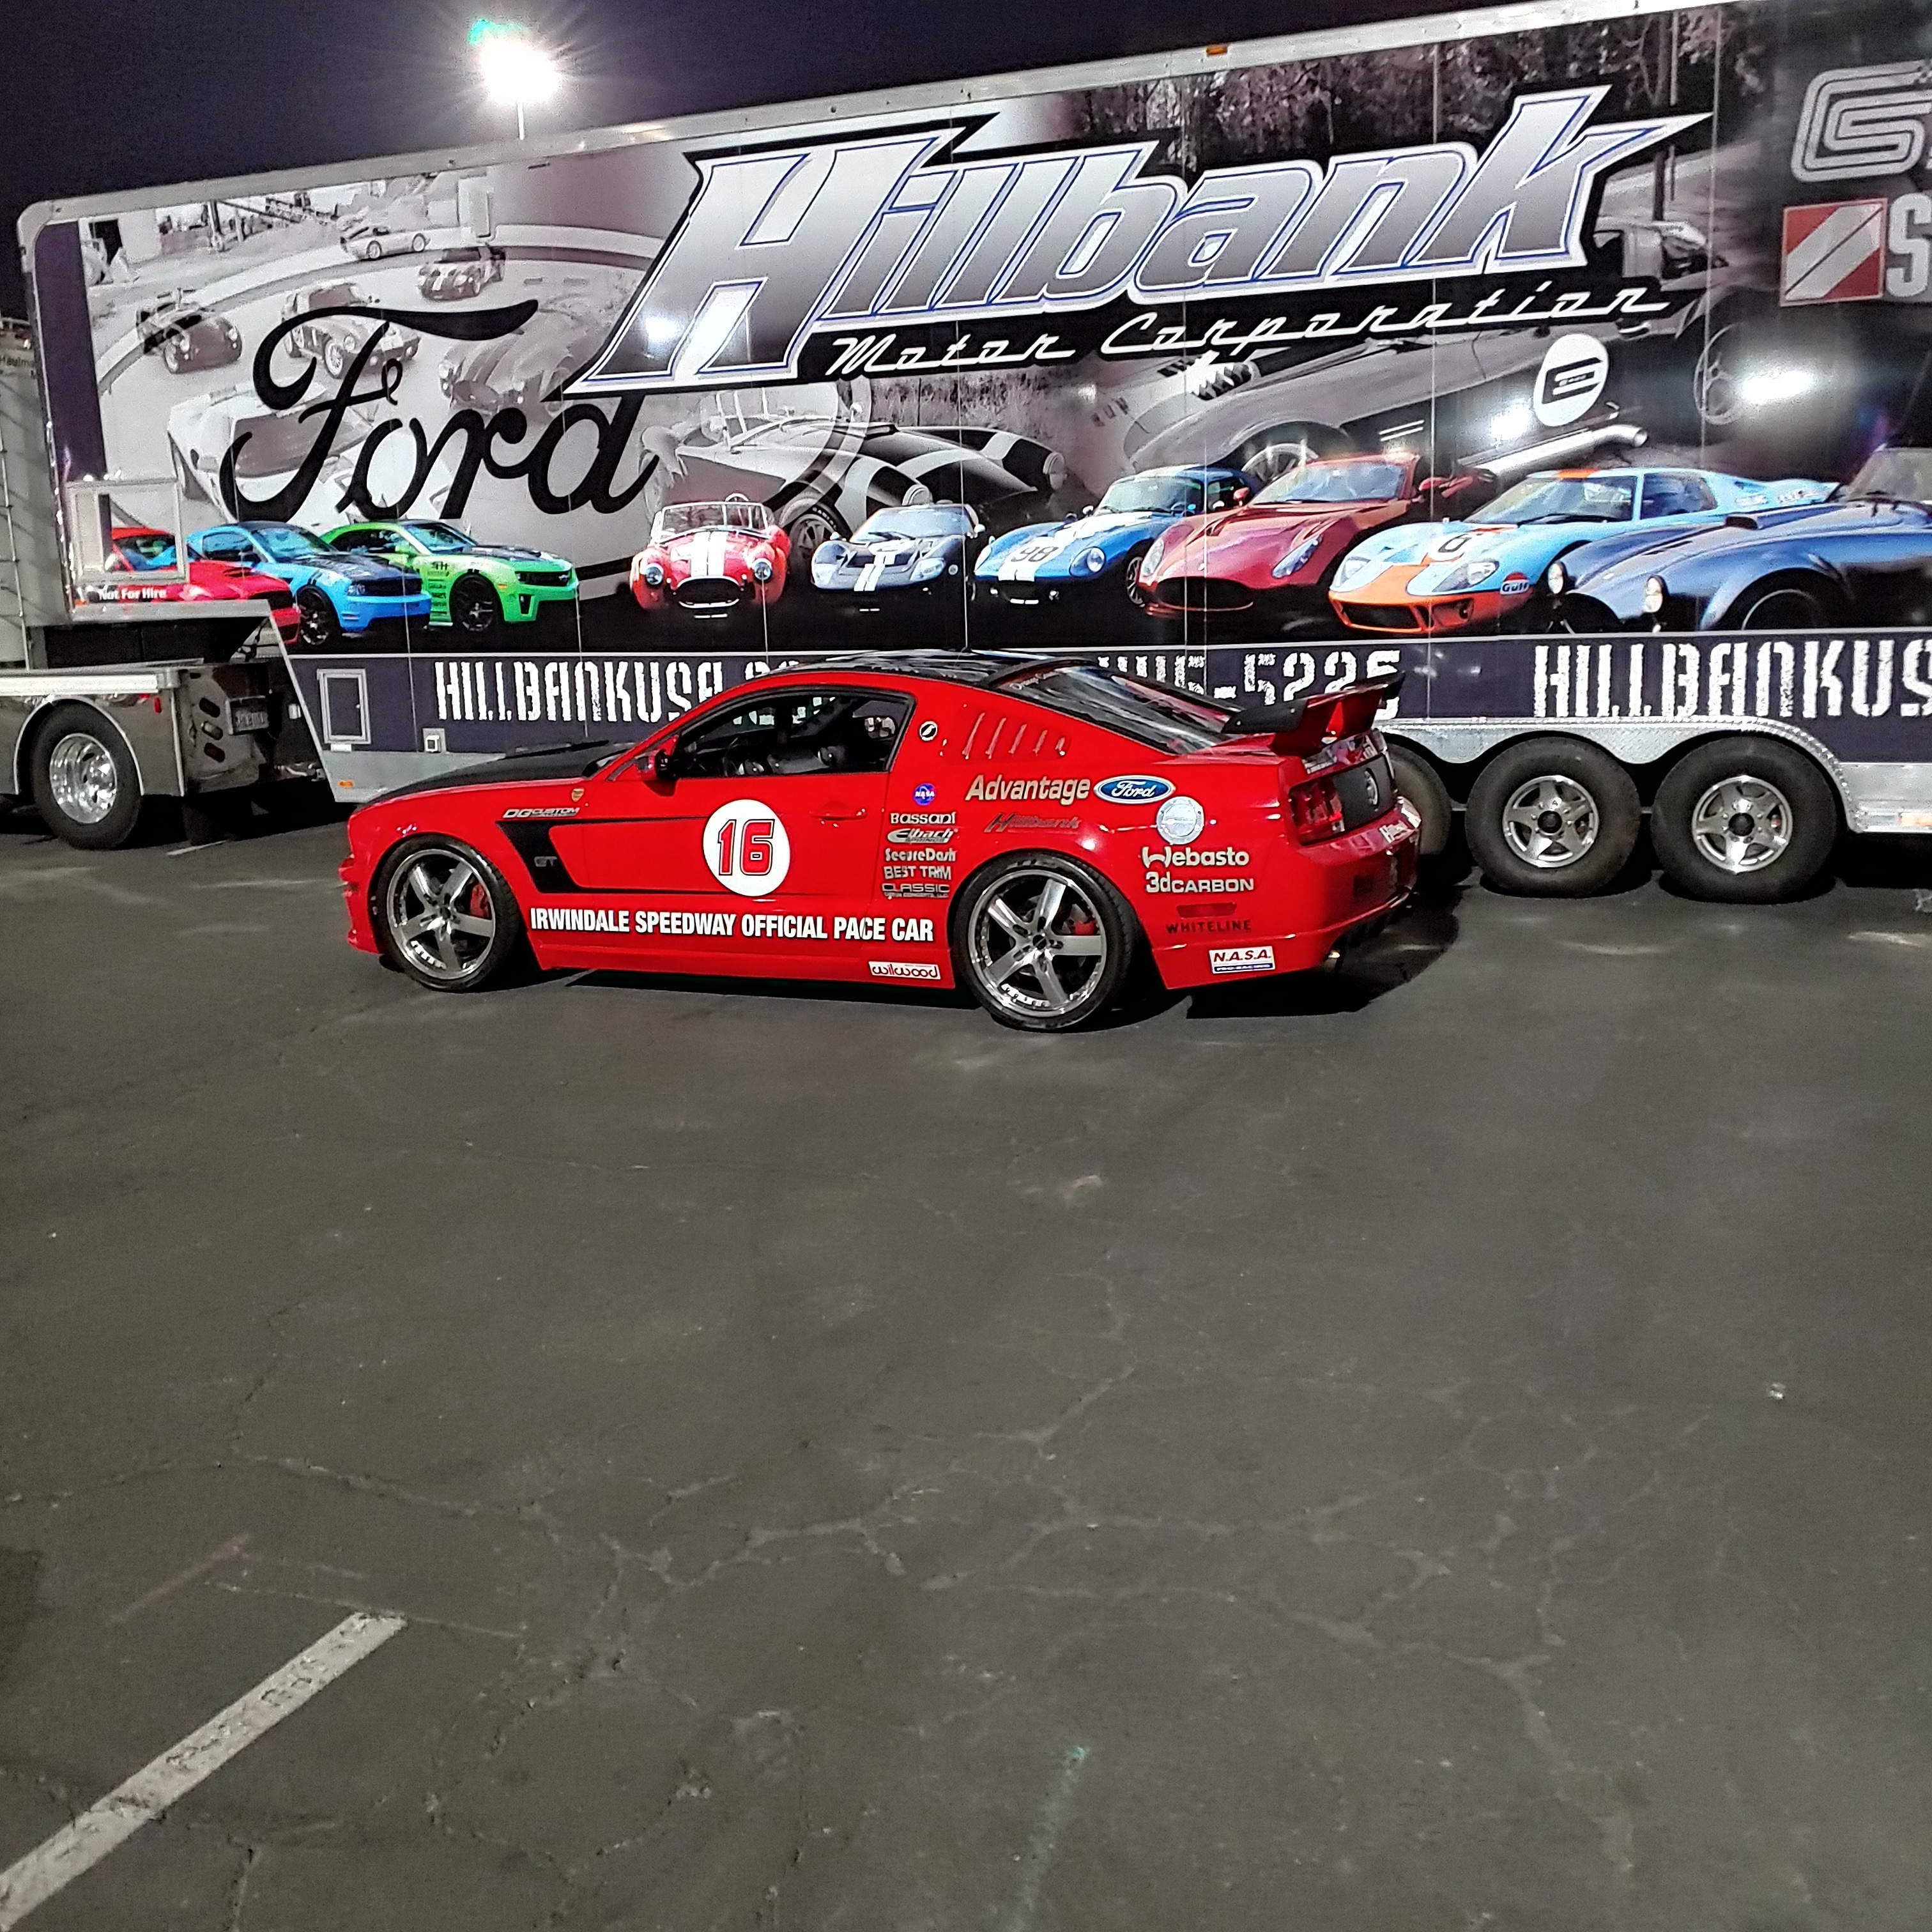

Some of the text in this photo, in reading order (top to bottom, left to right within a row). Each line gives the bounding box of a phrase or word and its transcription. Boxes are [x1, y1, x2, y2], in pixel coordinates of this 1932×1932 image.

[564, 84, 1714, 394] Hillbank
[825, 281, 1670, 376] Motor Corporation
[220, 300, 659, 522] Ford
[121, 588, 140, 599] For
[142, 587, 166, 599] Hire
[1501, 582, 1529, 594] Gulf
[965, 774, 1090, 805] Advantage
[1112, 780, 1154, 797] Ford
[717, 819, 775, 876] 16
[885, 847, 956, 862] SecureDash
[1142, 847, 1250, 868] Webasto
[884, 866, 951, 880] BEST TRIM
[882, 883, 950, 893] CLASSIC
[530, 907, 933, 942] IRWINDALE SPEEDWAY OFFICIAL PACE CAR
[1166, 920, 1252, 933] WHITELINE
[872, 963, 938, 977] wilwood
